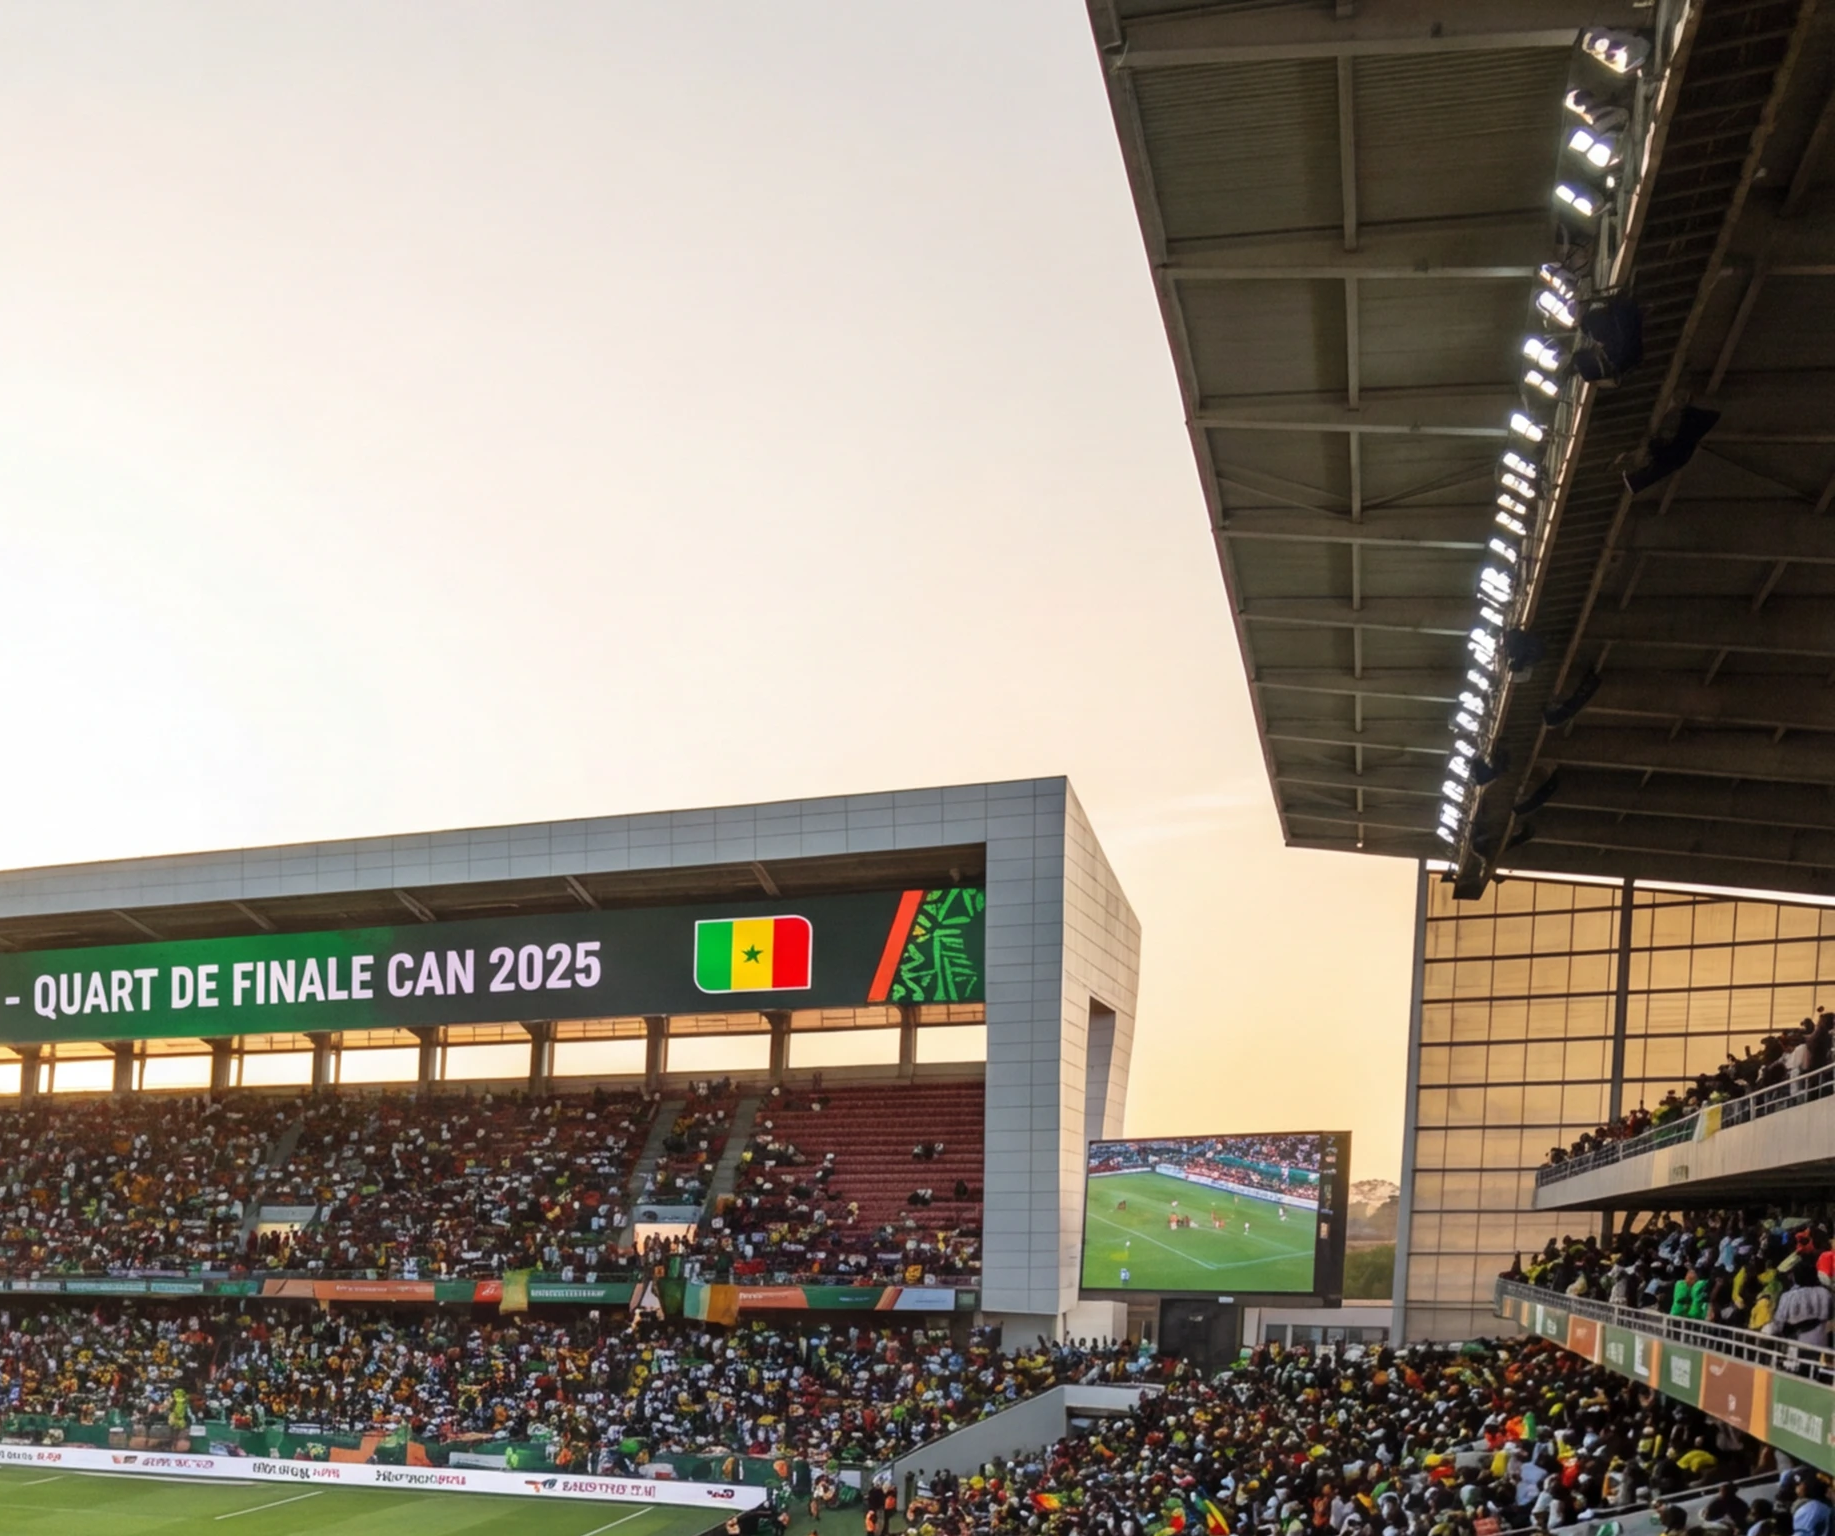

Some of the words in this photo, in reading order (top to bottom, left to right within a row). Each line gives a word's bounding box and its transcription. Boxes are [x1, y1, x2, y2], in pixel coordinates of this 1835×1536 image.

[34, 968, 159, 1020] QUART
[171, 964, 220, 1009] DE
[233, 955, 375, 1006] FINALE
[387, 949, 475, 997] CAN
[489, 941, 602, 992] 2025
